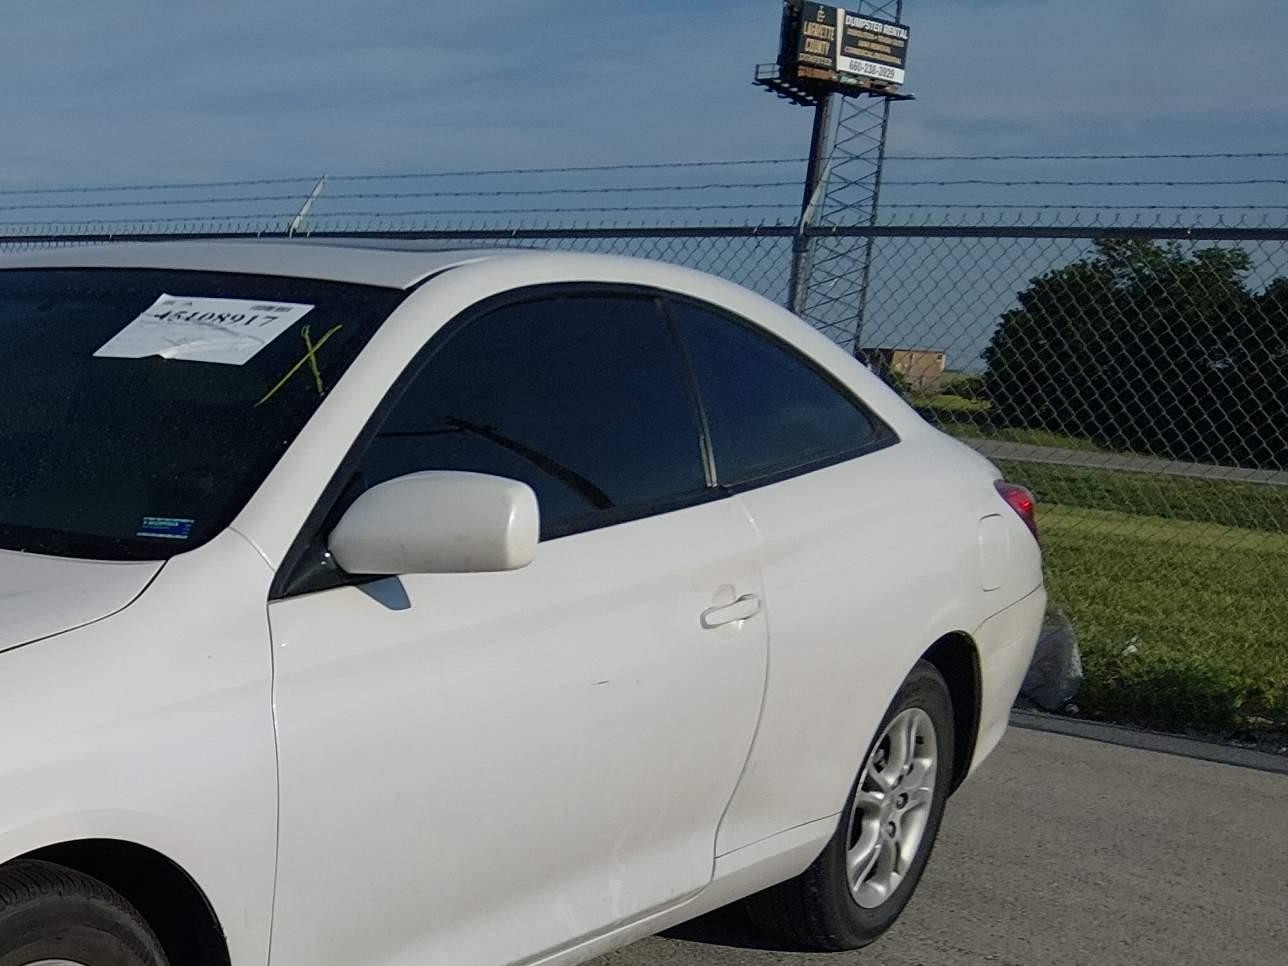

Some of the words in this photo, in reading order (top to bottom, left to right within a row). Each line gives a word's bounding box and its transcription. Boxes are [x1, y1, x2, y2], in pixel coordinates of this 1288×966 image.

[845, 15, 882, 32] DUMPSTER
[882, 23, 909, 39] RENTAL
[154, 310, 279, 328] 45108917
